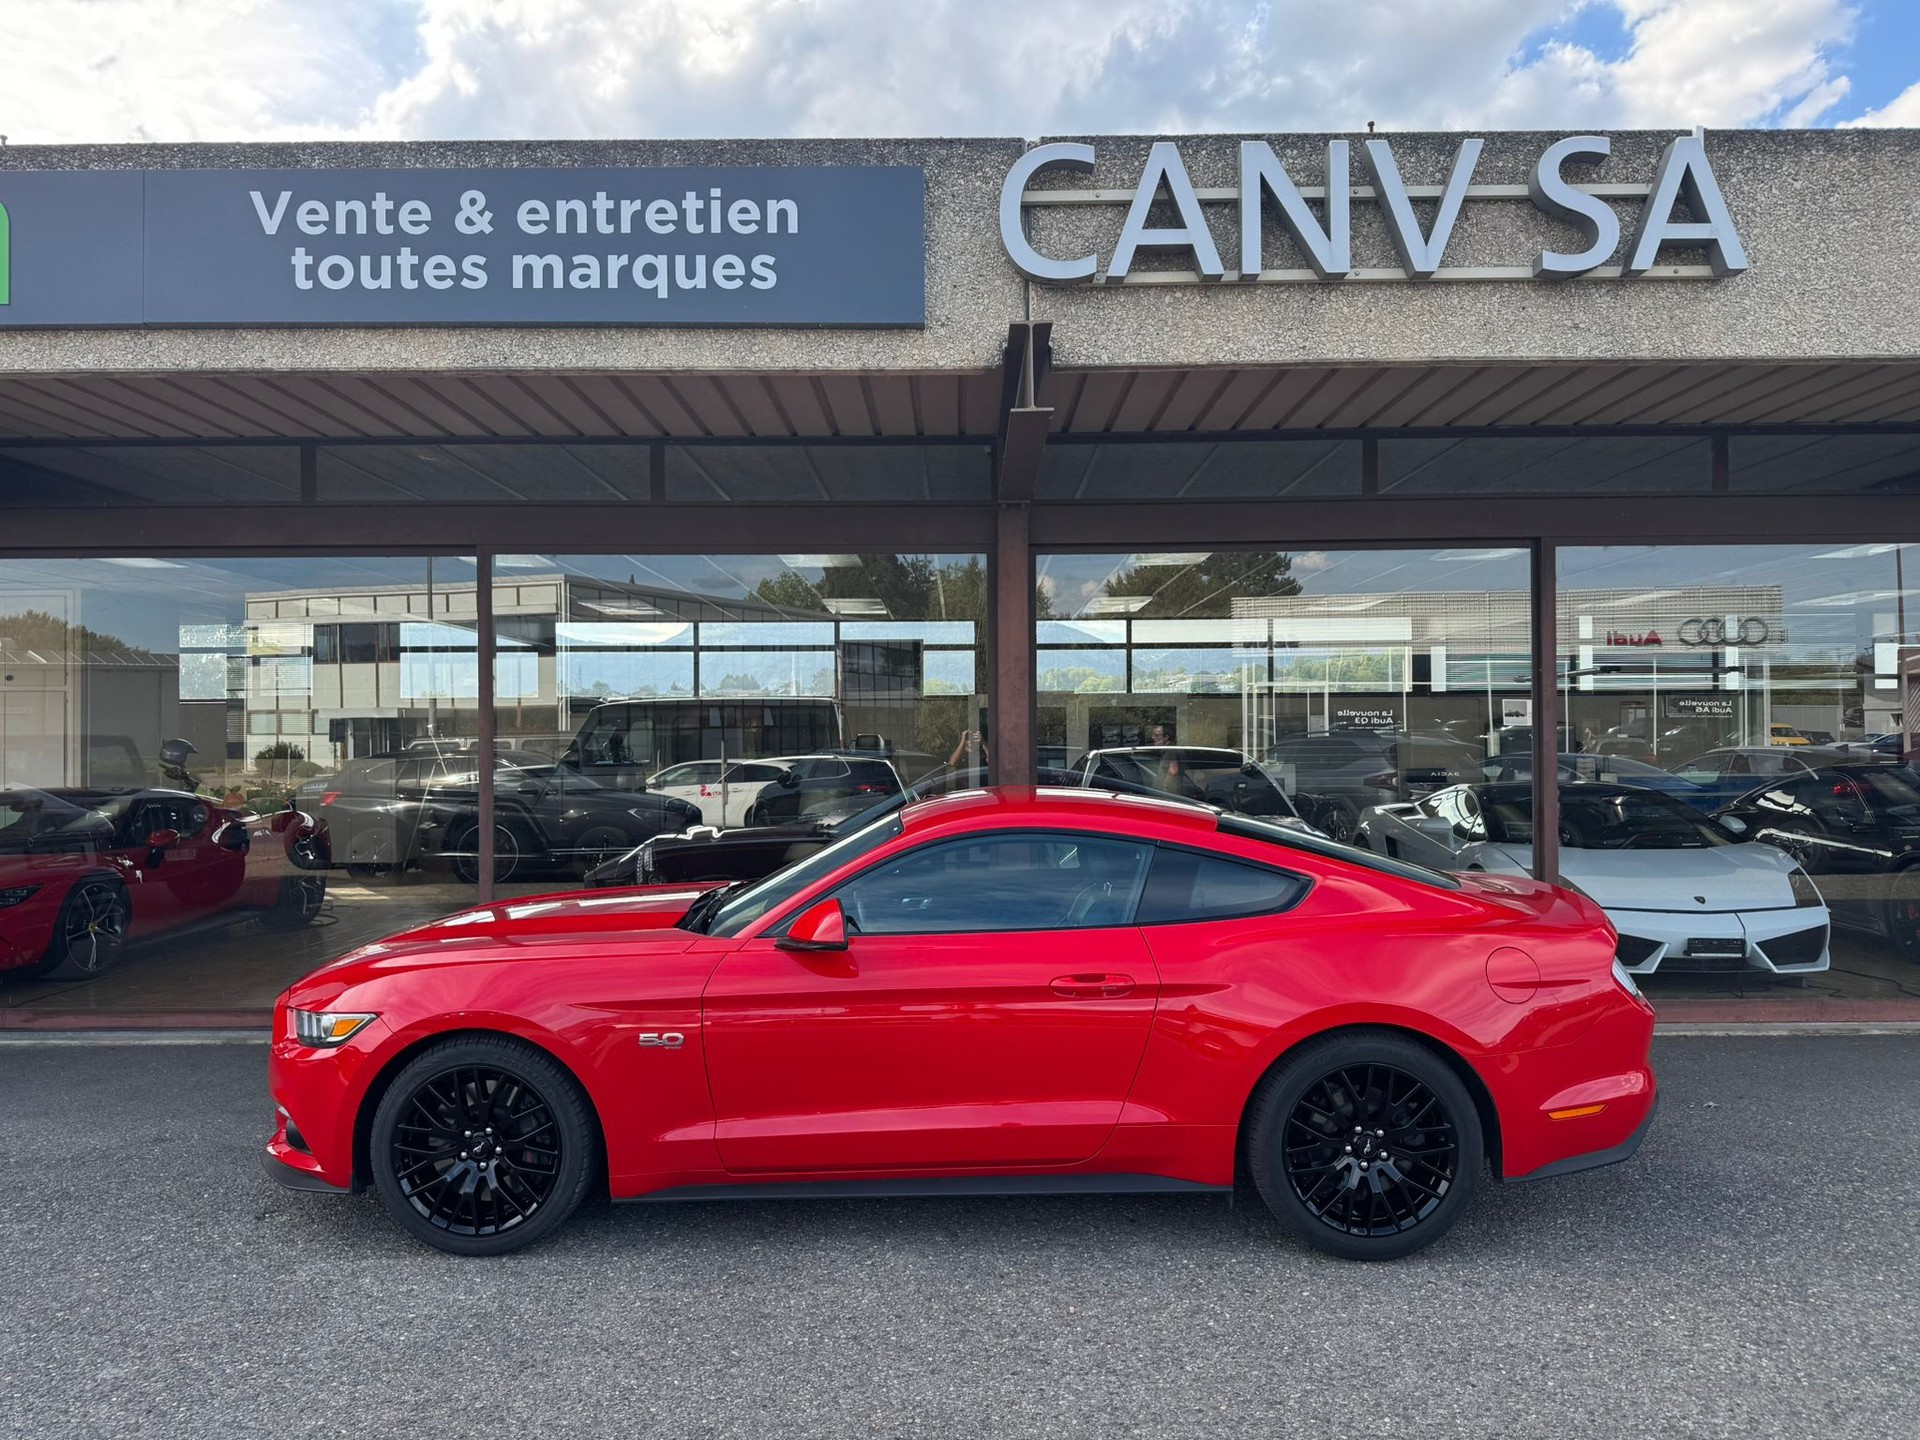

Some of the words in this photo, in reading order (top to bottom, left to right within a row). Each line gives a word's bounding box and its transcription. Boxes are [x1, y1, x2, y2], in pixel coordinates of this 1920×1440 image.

[249, 190, 432, 235] Vente
[455, 189, 494, 235] &
[516, 188, 799, 235] entretien
[998, 137, 1486, 282] CANV
[1528, 135, 1749, 279] SA
[292, 247, 488, 290] toutes
[512, 254, 777, 299] marques
